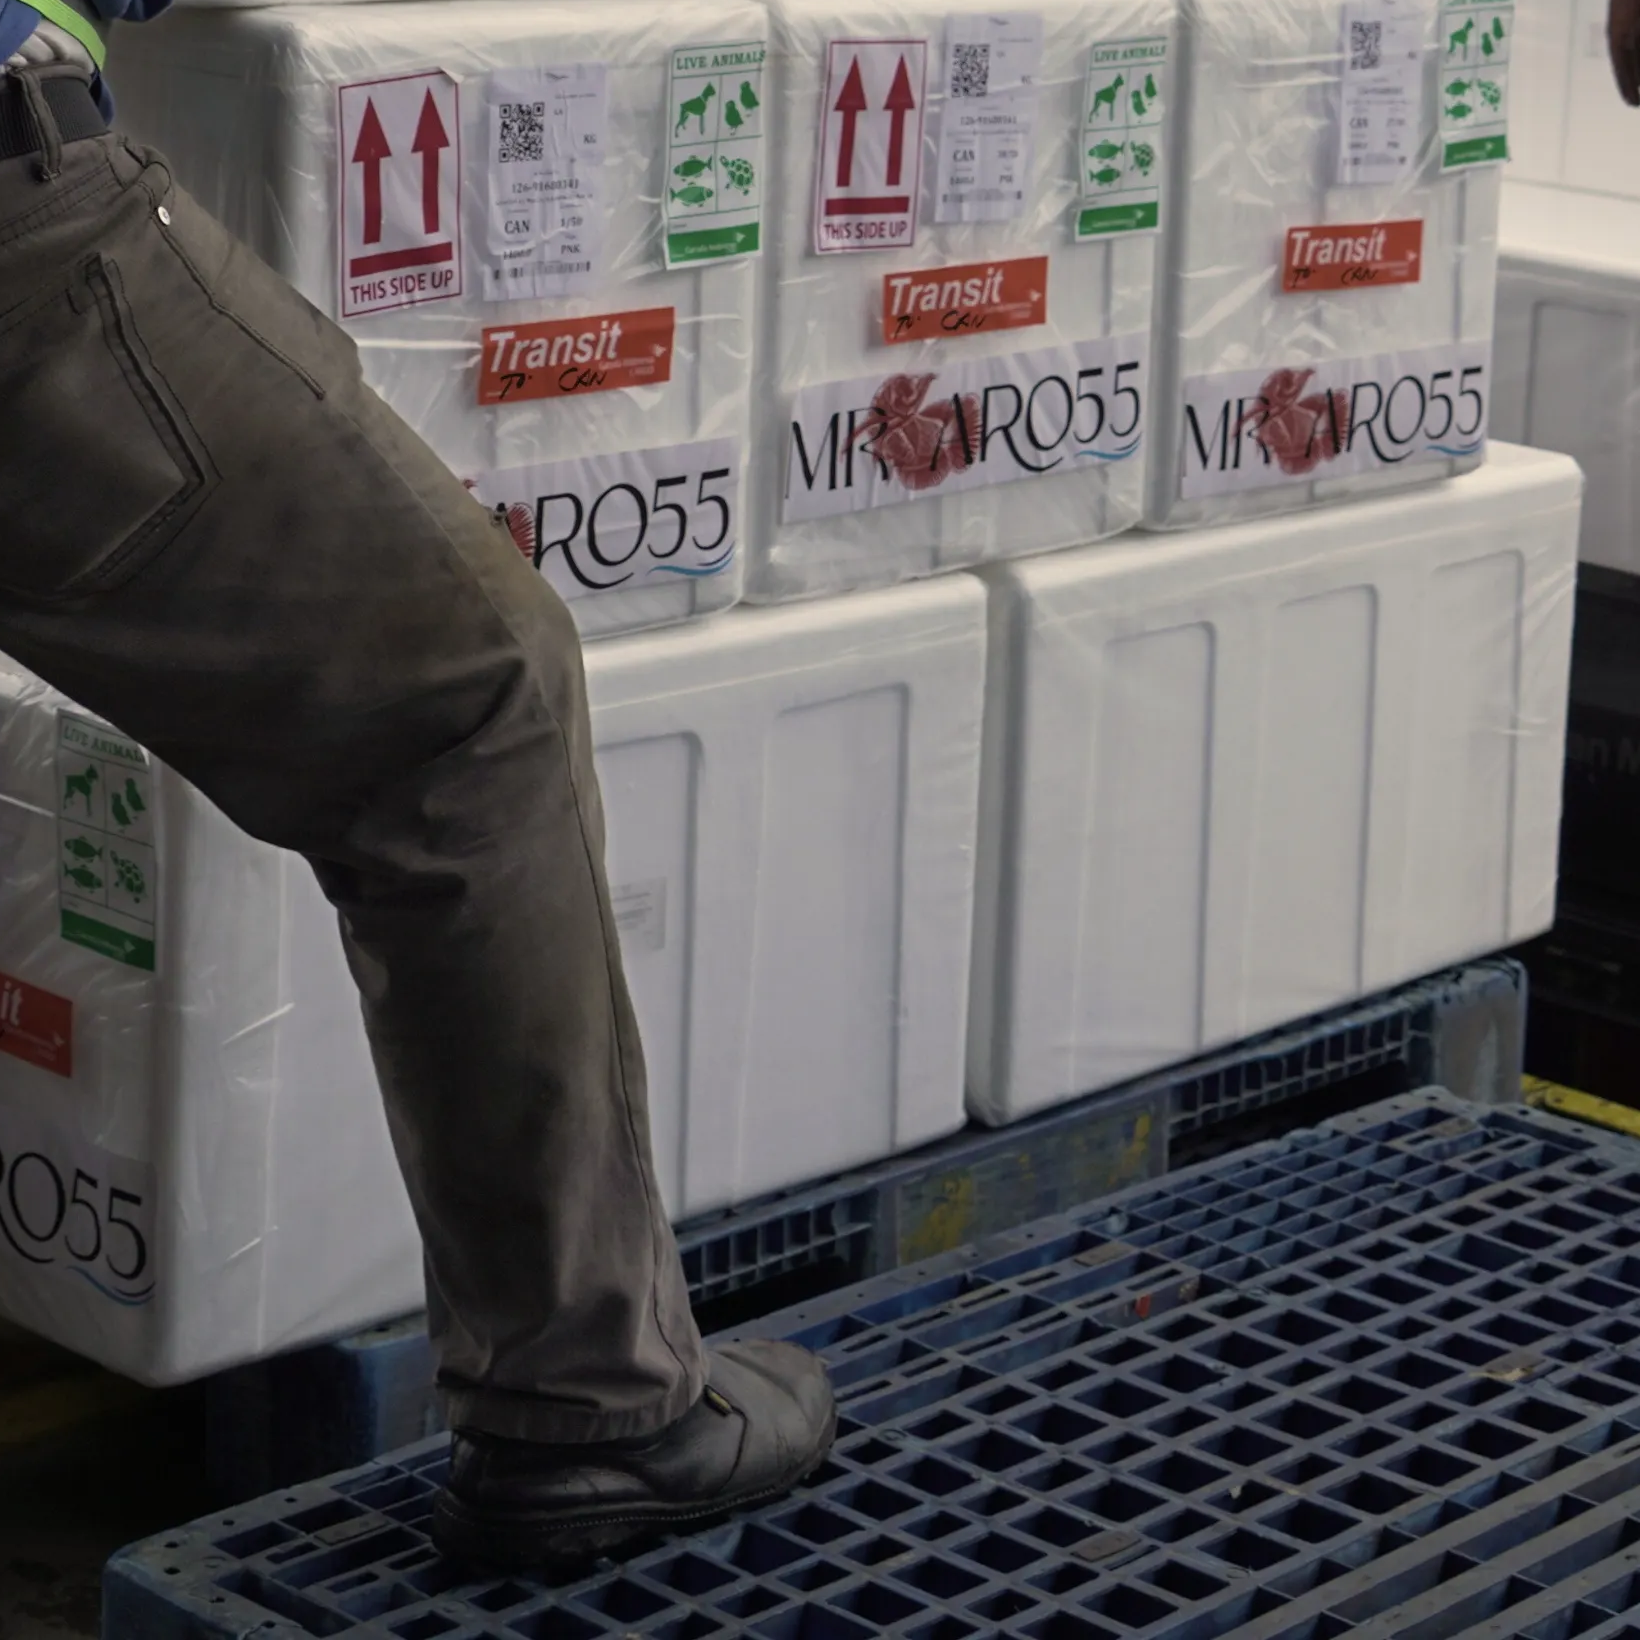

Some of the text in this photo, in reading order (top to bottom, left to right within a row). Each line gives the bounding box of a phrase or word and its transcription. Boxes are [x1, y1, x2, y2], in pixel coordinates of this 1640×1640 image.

[675, 49, 767, 71] LIVE ANIMALS
[1093, 48, 1120, 63] LIVE
[504, 220, 531, 235] CAN
[823, 222, 908, 241] THIS SIDE UP
[1291, 227, 1386, 267] Transit
[350, 269, 455, 305] THIS SIDE UP
[889, 268, 1005, 316] Transit
[488, 320, 622, 373] Transit
[928, 361, 1141, 474] ARO55
[1304, 365, 1483, 463] ARO55
[495, 468, 730, 590] RO55
[63, 725, 89, 748] LIVE
